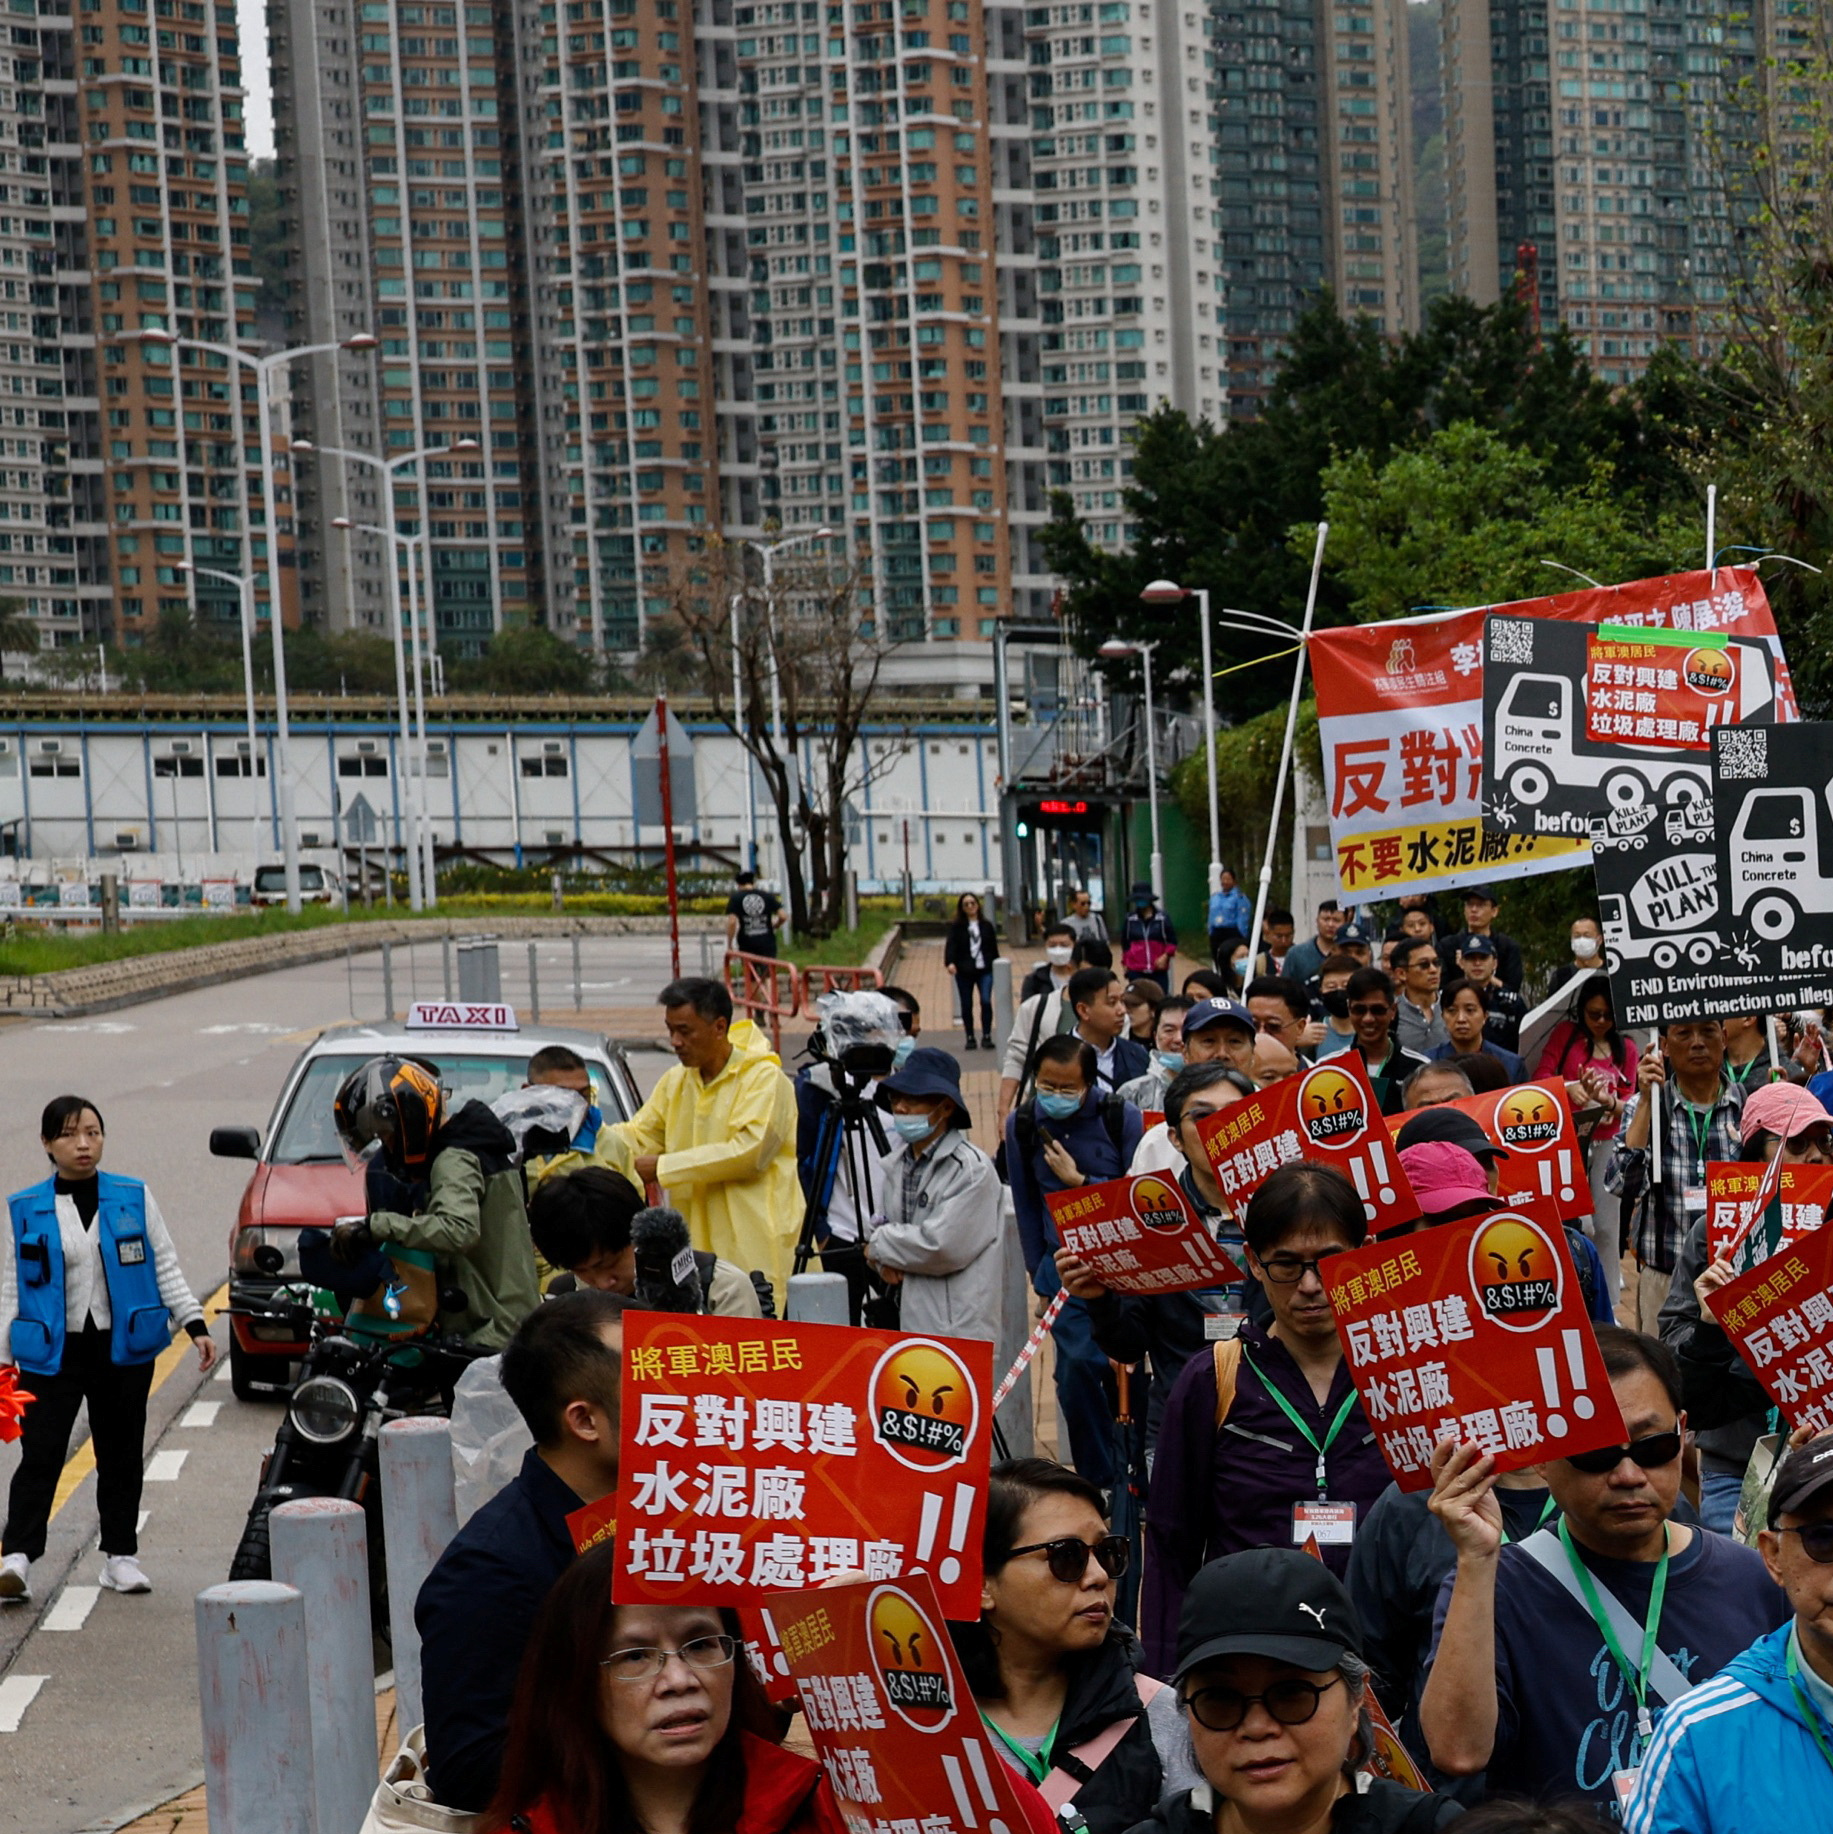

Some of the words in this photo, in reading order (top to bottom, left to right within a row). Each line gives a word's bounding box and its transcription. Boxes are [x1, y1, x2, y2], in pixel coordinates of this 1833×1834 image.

[1592, 663, 1678, 690] 反對興建
[1592, 689, 1656, 713] 水泥廠
[1504, 724, 1533, 738] China
[1591, 712, 1699, 740] 垃圾處理廠
[1504, 741, 1553, 755] Concrete
[1616, 812, 1650, 833] PLANT
[1741, 850, 1774, 864] China
[1742, 869, 1797, 882] Concrete
[1645, 860, 1701, 898] KILL
[1632, 976, 1663, 997] END
[417, 1005, 506, 1025] TAXI
[1626, 1003, 1659, 1024] END
[1663, 1000, 1701, 1019] Govt
[1704, 991, 1771, 1016] inaction
[1776, 990, 1797, 1007] on
[1206, 1102, 1266, 1161] 將軍澳居民
[1217, 1129, 1304, 1196] 反對興建
[1710, 1172, 1795, 1197] 將軍澳民
[1062, 1216, 1143, 1254] 反對興建
[1330, 1249, 1422, 1316] 將軍澳居民
[1721, 1256, 1810, 1335] 將軍澳居民
[1345, 1294, 1474, 1368] 反對興建
[630, 1337, 803, 1382] 將軍澳居民
[1363, 1360, 1454, 1422] 水泥廠
[633, 1393, 858, 1457] 反對興建
[629, 1459, 808, 1520] 水泥廠
[796, 1672, 886, 1733] 反對興建
[822, 1745, 883, 1804] 水泥廠
